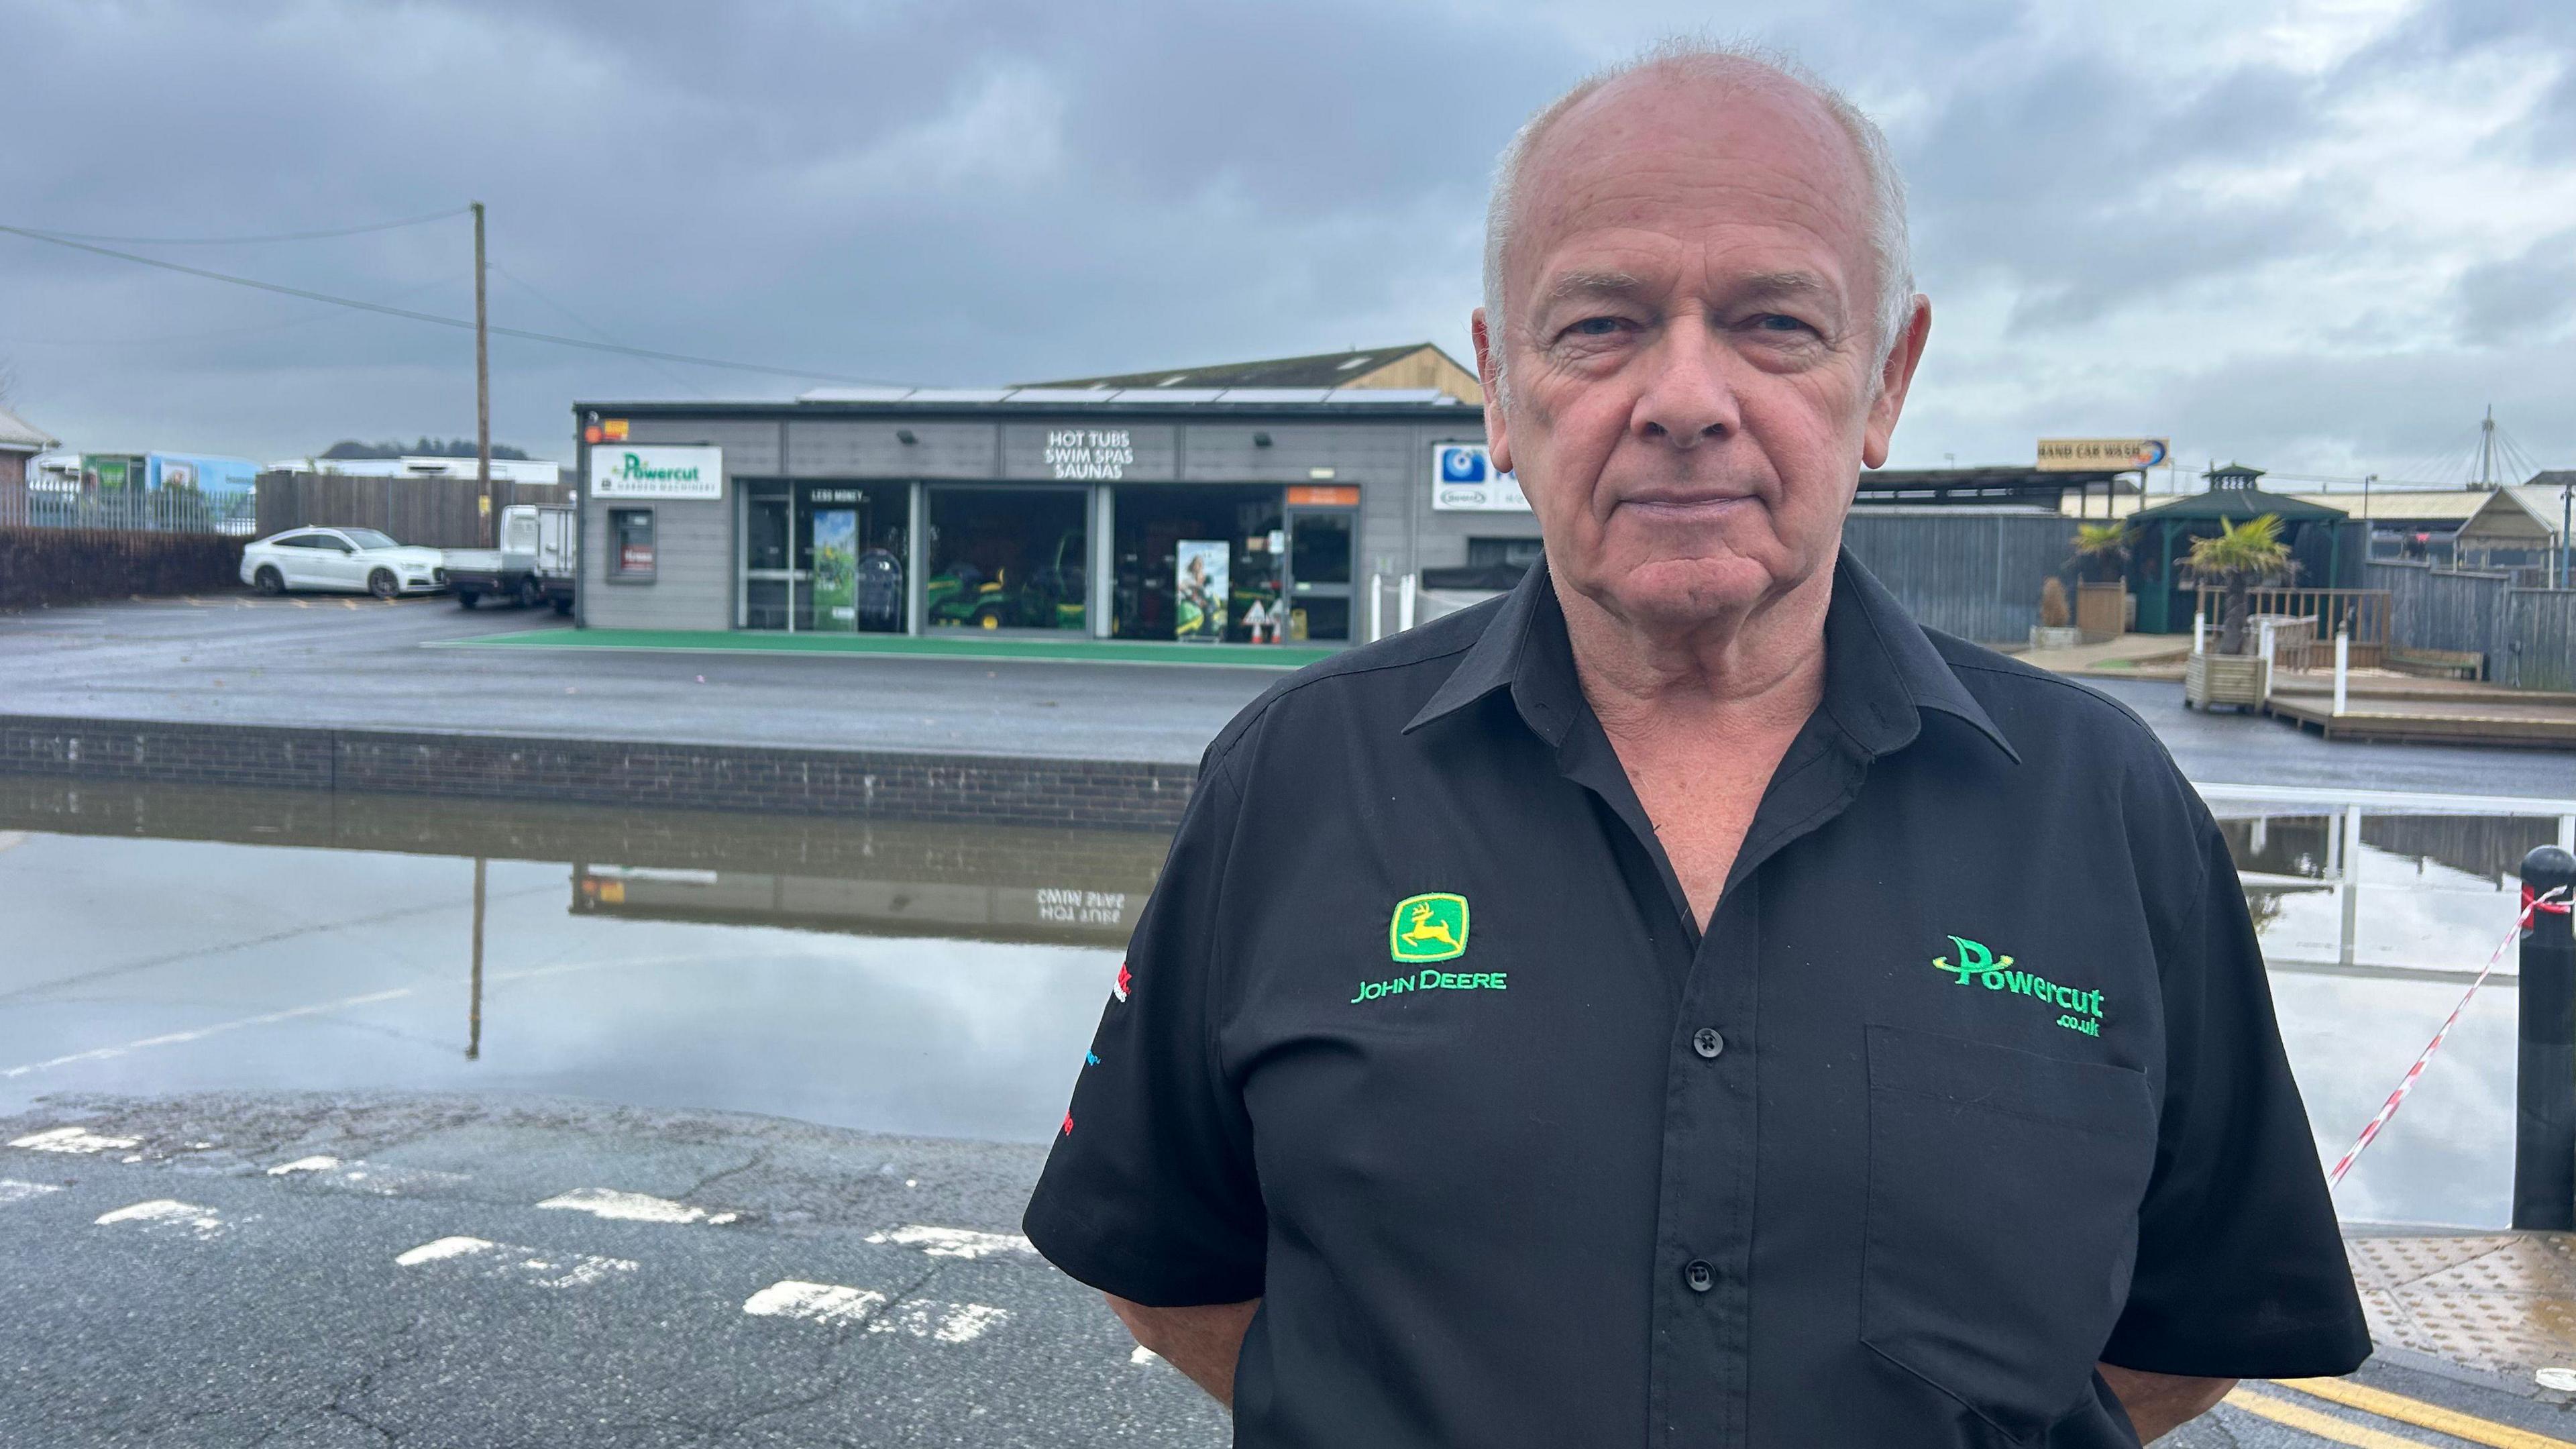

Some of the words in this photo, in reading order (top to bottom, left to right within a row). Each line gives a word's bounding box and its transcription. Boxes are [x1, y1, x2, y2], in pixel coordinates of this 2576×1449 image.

[1047, 429, 1085, 447] HOT
[1088, 429, 1130, 447] TUBS
[1043, 447, 1091, 464] SWIM
[1093, 447, 1134, 464] SPAS
[2076, 443, 2100, 460] CAR
[623, 451, 700, 481] Powercut
[1054, 462, 1123, 479] SAUNAS
[1350, 974, 1416, 1004] JOHN
[1419, 969, 1508, 990] DEERE
[1945, 934, 2104, 1019] Powercut
[2055, 1014, 2100, 1038] .co.uk
